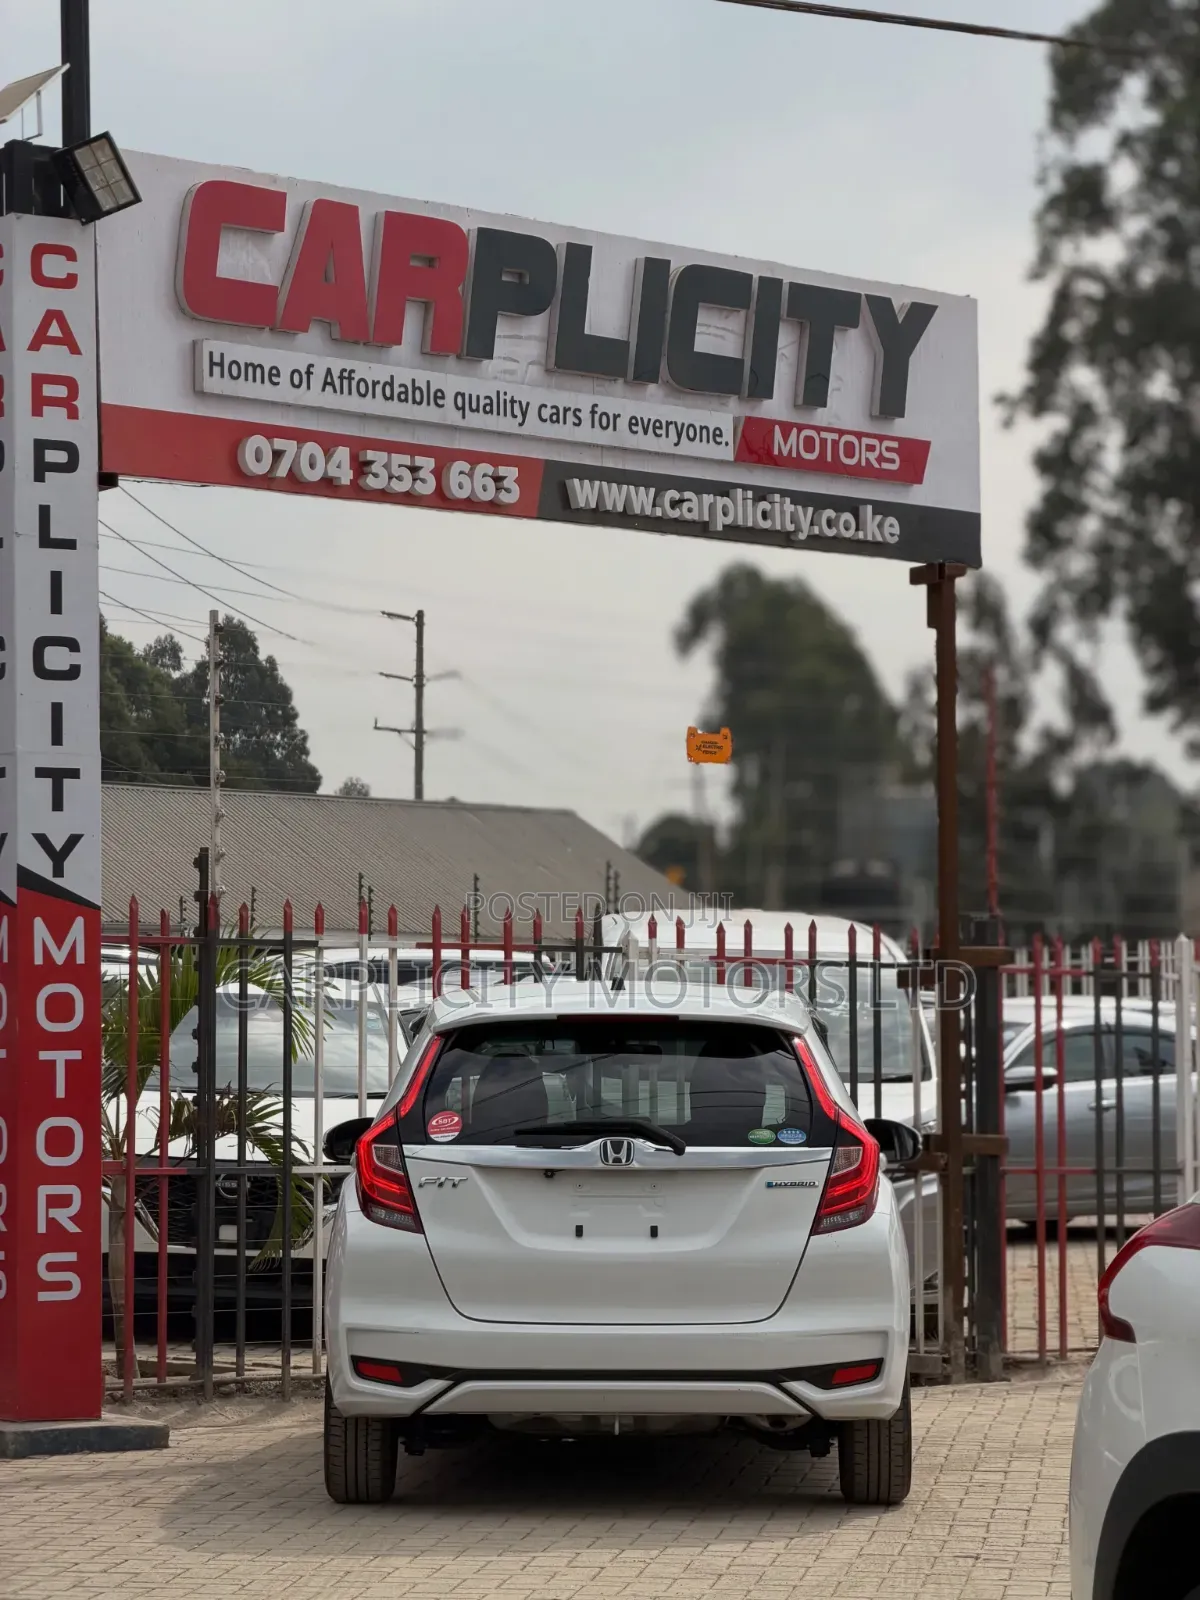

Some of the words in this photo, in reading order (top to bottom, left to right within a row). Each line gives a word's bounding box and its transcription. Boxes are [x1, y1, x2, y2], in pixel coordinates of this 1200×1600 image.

[176, 180, 939, 419] CARPLICITY
[208, 350, 281, 386] Home
[289, 363, 315, 391] of
[321, 367, 446, 408] Affordable
[453, 390, 530, 427] quality
[537, 403, 583, 428] cars
[589, 403, 622, 432] for
[627, 414, 730, 447] everyone.
[237, 434, 353, 485] 0704
[359, 449, 436, 496] 353
[442, 460, 520, 506] 663
[773, 424, 901, 471] MOTORS
[565, 477, 901, 544] www.carplicity.co.ke
[27, 243, 83, 878] CARPLICITY
[33, 915, 86, 1302] MOTORS
[418, 1176, 468, 1188] FIT
